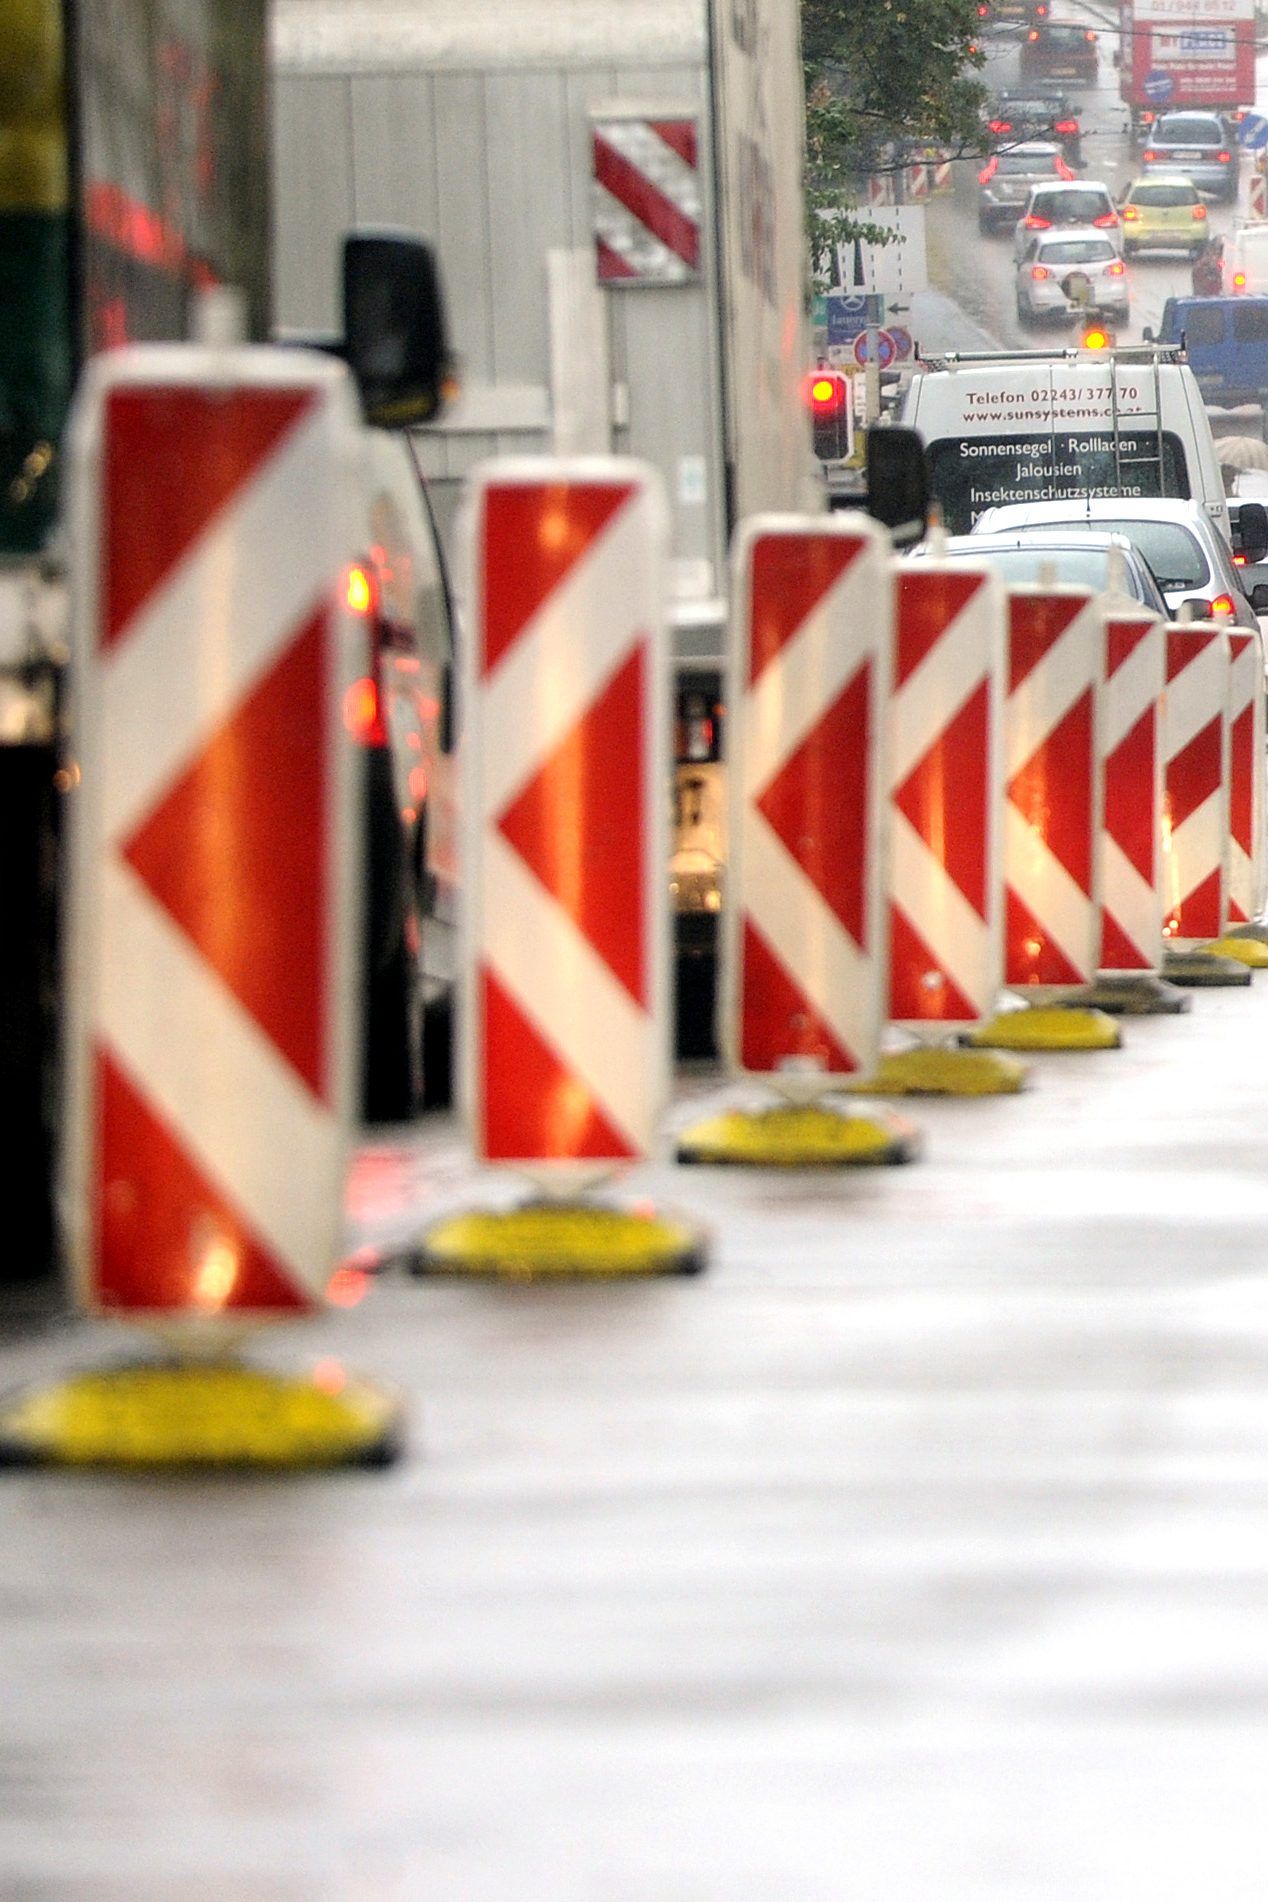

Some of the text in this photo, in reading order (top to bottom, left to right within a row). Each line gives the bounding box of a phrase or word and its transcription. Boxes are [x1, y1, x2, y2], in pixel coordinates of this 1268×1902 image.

[966, 391, 1024, 405] Telefon
[1087, 387, 1113, 400] 377
[1120, 387, 1137, 399] 70
[960, 439, 1052, 458] Sonnensegel
[1015, 462, 1082, 481] Jalousien
[970, 484, 1142, 503] Insektenschutzsysteme
